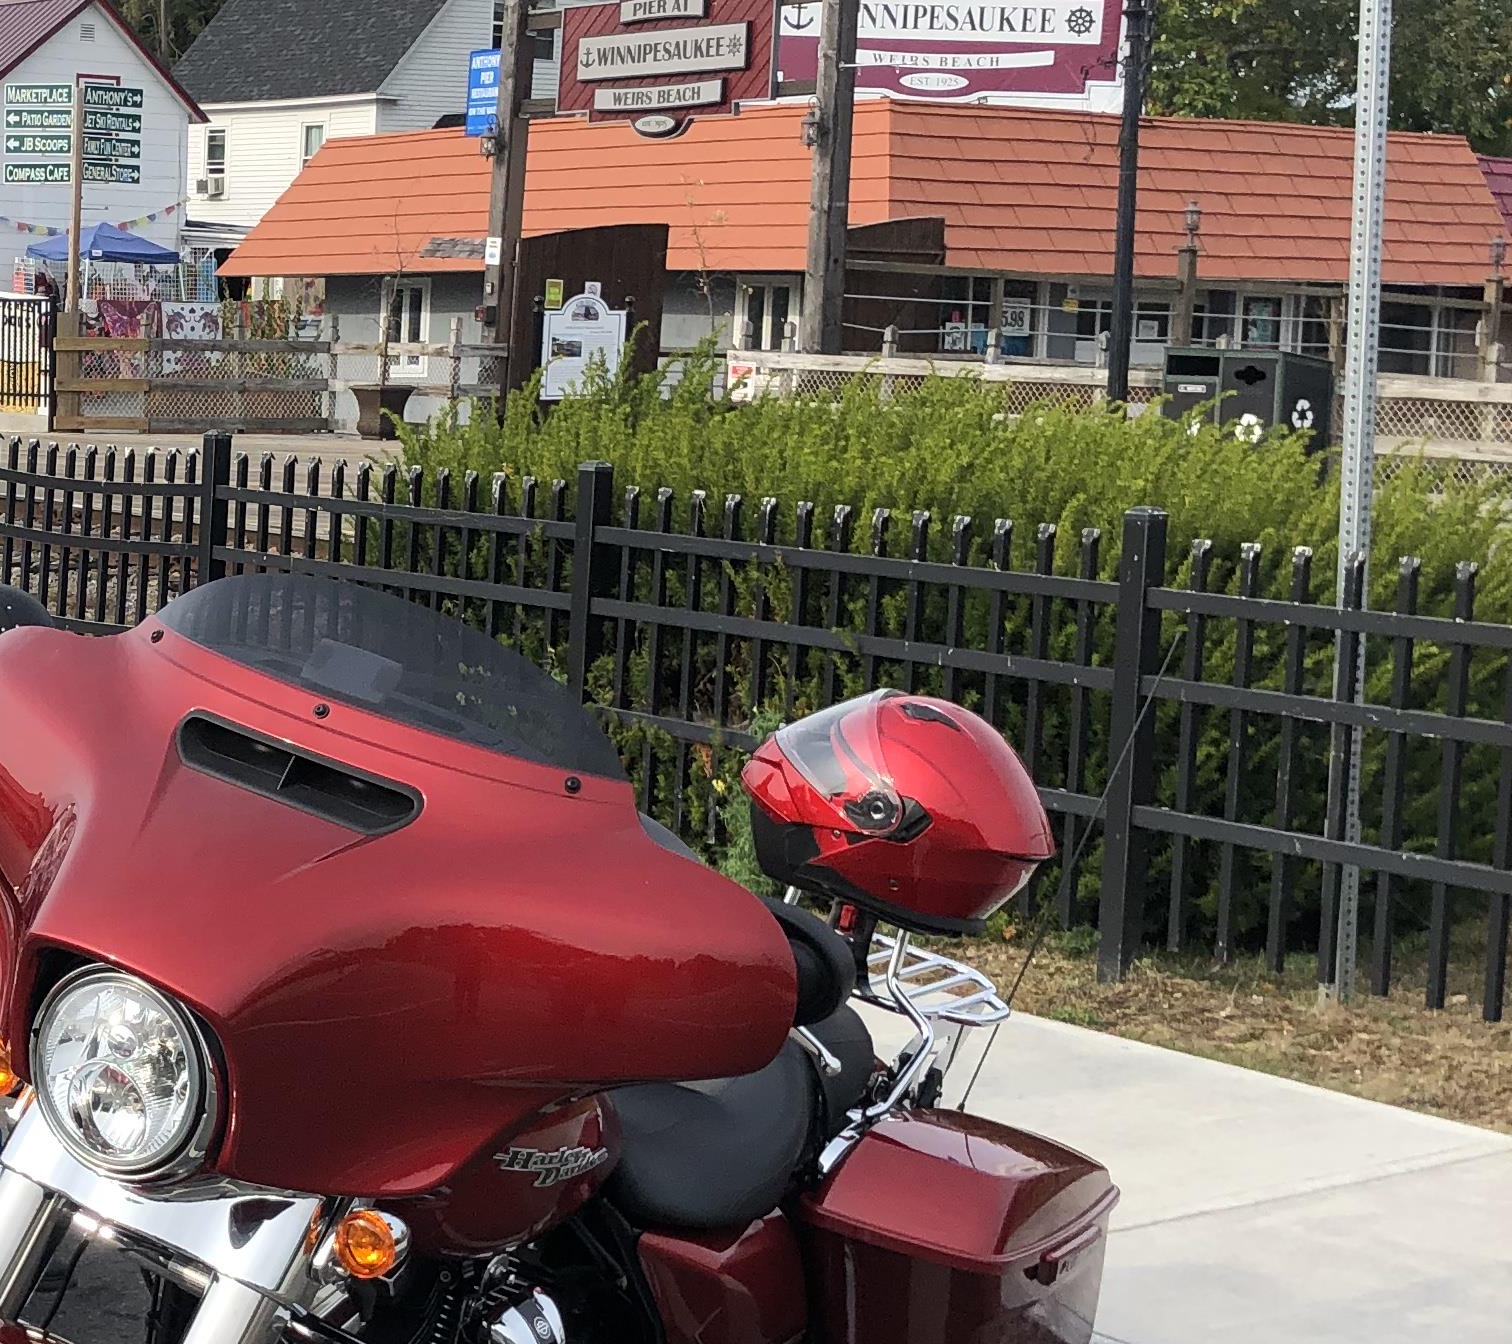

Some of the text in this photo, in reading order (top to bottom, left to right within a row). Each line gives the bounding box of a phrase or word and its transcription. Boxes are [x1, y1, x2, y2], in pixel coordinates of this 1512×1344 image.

[632, 0, 668, 17] PIER
[860, 2, 1057, 34] NNIPESAUKEE
[597, 35, 726, 67] WINNIPESAUKEE
[472, 54, 500, 69] ANTHONY
[872, 53, 1000, 68] WEIRS BEACH
[910, 77, 959, 88] EST 1925
[7, 86, 69, 103] MARKETPLACE
[85, 87, 133, 106] ANTHONY'S
[613, 86, 701, 107] WEIRS BEACH
[21, 111, 72, 126] PATIO GARDEN
[84, 113, 133, 131] JET SKI RENTALS
[21, 136, 68, 152] JB SCOOPS
[100, 138, 111, 155] FUN
[6, 164, 69, 181] COMPASS CAFE
